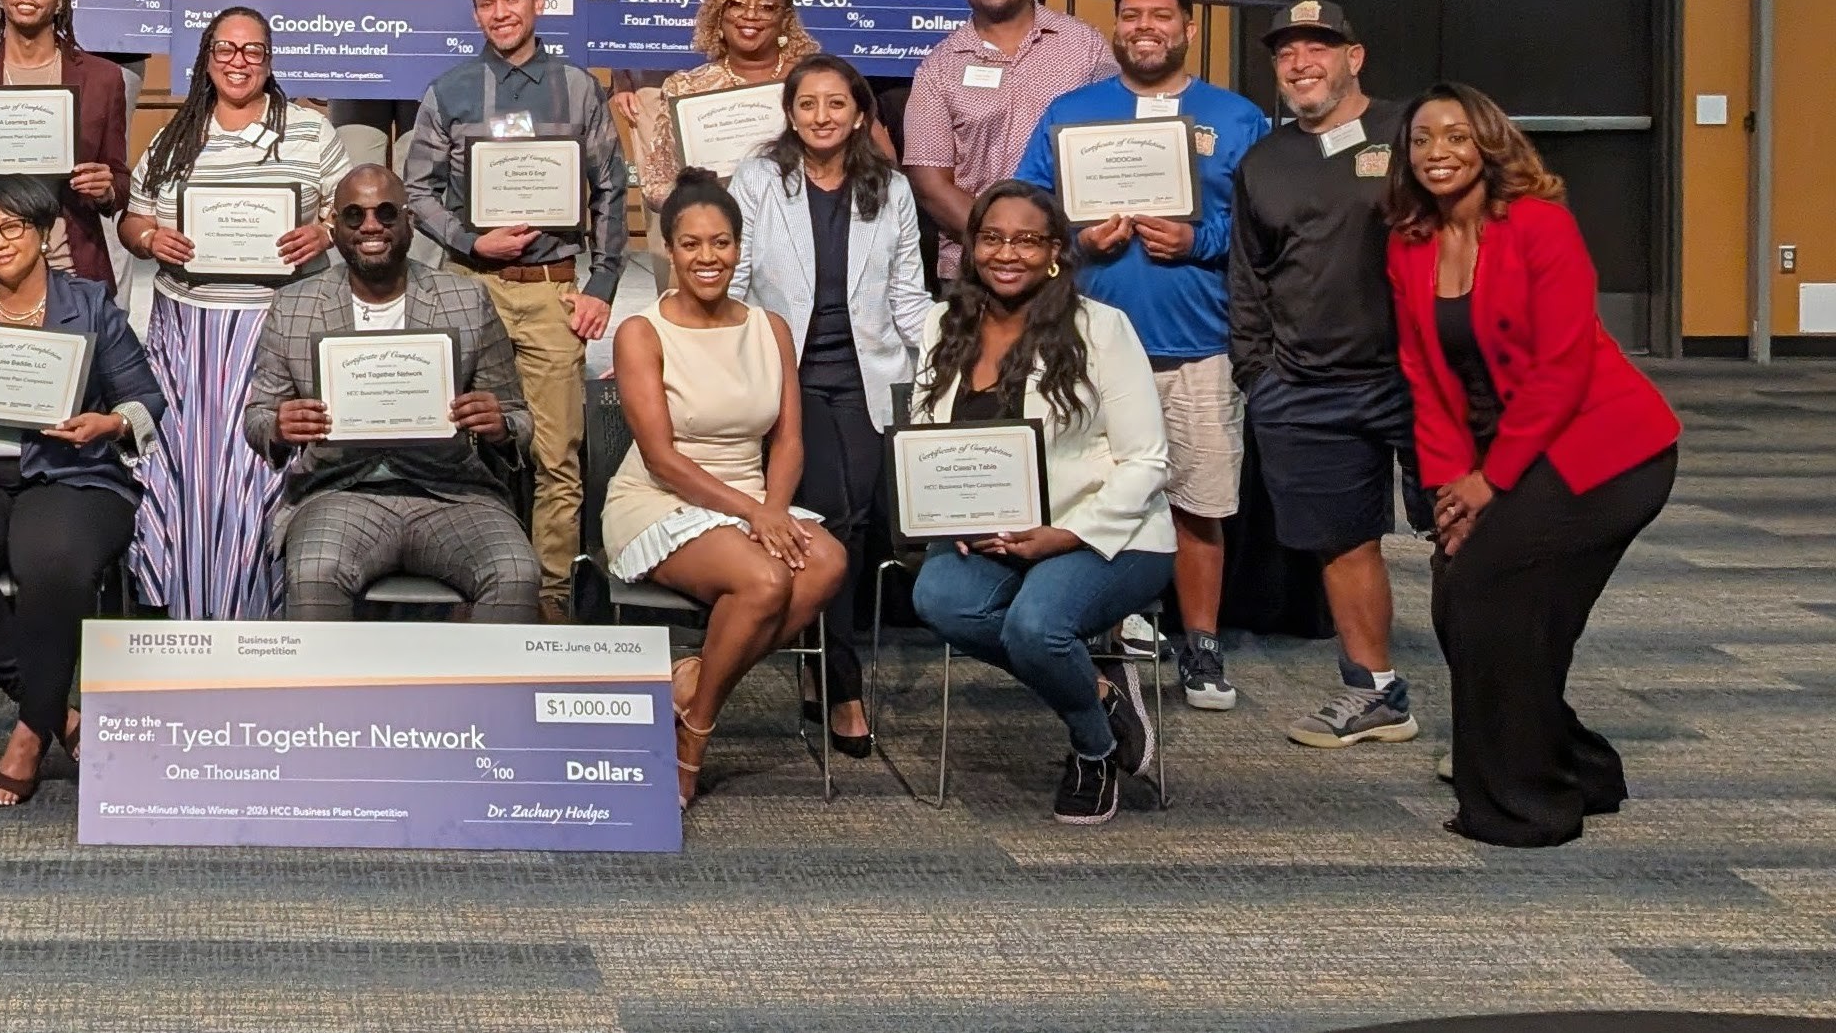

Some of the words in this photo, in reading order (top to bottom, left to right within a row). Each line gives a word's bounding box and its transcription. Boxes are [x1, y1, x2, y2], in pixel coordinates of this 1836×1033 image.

[270, 15, 355, 36] Goodbye
[361, 16, 413, 37] Corp.
[624, 15, 650, 25] Four
[315, 44, 336, 55] Five
[340, 44, 388, 55] Hundred
[346, 72, 383, 80] Competition
[129, 634, 212, 646] HOUSTON
[238, 636, 278, 645] Business
[281, 636, 301, 645] Plan
[238, 647, 297, 656] Competition
[526, 641, 563, 652] DATE:
[565, 642, 590, 652] June
[594, 643, 611, 654] 04,
[615, 643, 641, 653] 2026
[548, 699, 631, 717] $1,000.00
[99, 716, 121, 729] Pay
[125, 717, 138, 727] to
[141, 716, 161, 728] the
[99, 730, 134, 742] Order
[139, 730, 155, 742] of:
[166, 722, 231, 752] Tyed
[239, 722, 361, 753] Together
[371, 725, 486, 749] Network
[166, 765, 200, 780] One
[203, 764, 280, 780] Thousand
[567, 761, 643, 781] Dollars
[100, 802, 125, 814] For:
[127, 805, 178, 815] One-Minute
[180, 806, 206, 815] Video
[207, 806, 239, 816] Winner
[247, 806, 269, 816] 2026
[271, 806, 291, 816] HCC
[293, 807, 331, 816] Business
[333, 808, 352, 817] Plan
[354, 808, 408, 818] Competition
[488, 804, 507, 818] Dr.
[511, 803, 563, 824] Zachary
[566, 804, 609, 825] Hodges
